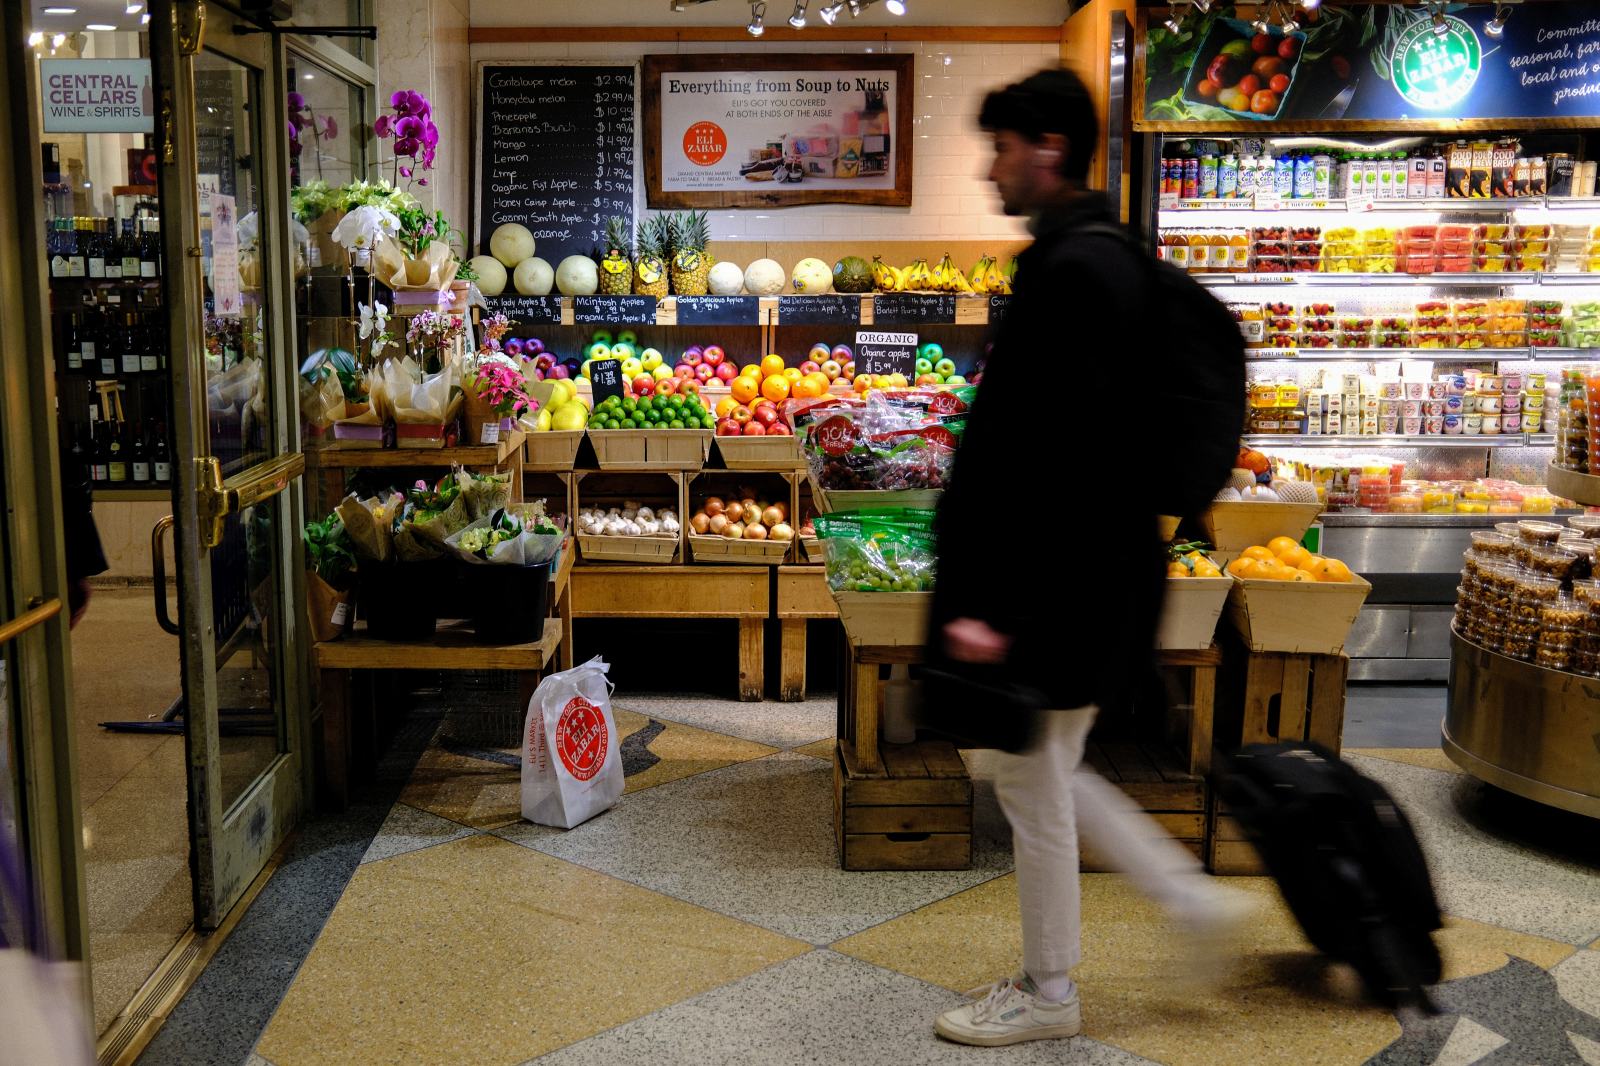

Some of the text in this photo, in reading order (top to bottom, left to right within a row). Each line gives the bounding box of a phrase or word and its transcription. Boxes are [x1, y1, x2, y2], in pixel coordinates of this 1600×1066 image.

[1395, 36, 1410, 60] NEW
[1411, 20, 1433, 34] YOR
[1419, 45, 1448, 65] ELI
[1510, 43, 1574, 67] seasonal,
[1521, 66, 1557, 86] local
[1560, 62, 1589, 79] and
[49, 75, 137, 88] CENTRAL
[489, 72, 544, 89] Cantaloupe
[550, 77, 577, 86] melon
[669, 78, 889, 95] Everything from Soup to Nuts
[50, 91, 137, 104] CELLARS
[491, 91, 535, 106] Honeydew
[539, 95, 566, 104] melon
[789, 99, 826, 107] COVERED
[51, 107, 140, 117] WINE & SPIRITS
[492, 111, 537, 122] Pineapple
[492, 125, 541, 135] Bananas
[493, 140, 526, 150] Mango
[696, 136, 714, 144] ELI
[687, 145, 723, 153] ZABAR
[494, 153, 529, 164] Lemon
[1451, 151, 1472, 160] COLD
[1473, 151, 1492, 160] COLD
[1494, 151, 1515, 160] COLD
[1450, 160, 1471, 168] BREW
[1474, 160, 1492, 168] BREW
[1493, 160, 1515, 168] BREW
[532, 179, 547, 191] Fuji
[550, 178, 578, 191] Apple
[493, 197, 521, 208] Honey
[552, 198, 576, 208] Apple
[531, 211, 558, 223] Smith
[560, 213, 583, 226] Apple
[501, 297, 515, 306] lady
[518, 297, 539, 307] Apples
[576, 297, 645, 306] Mcintosh Apples
[727, 297, 744, 305] Apples
[502, 307, 525, 316] Apples
[575, 314, 604, 322] organic
[860, 334, 914, 343] ORGANIC
[861, 346, 911, 362] Organic apples
[865, 362, 872, 373] $
[935, 396, 957, 413] JOY
[823, 425, 852, 443] JOY
[571, 722, 589, 746] ELI
[571, 724, 600, 765] ZABAR
